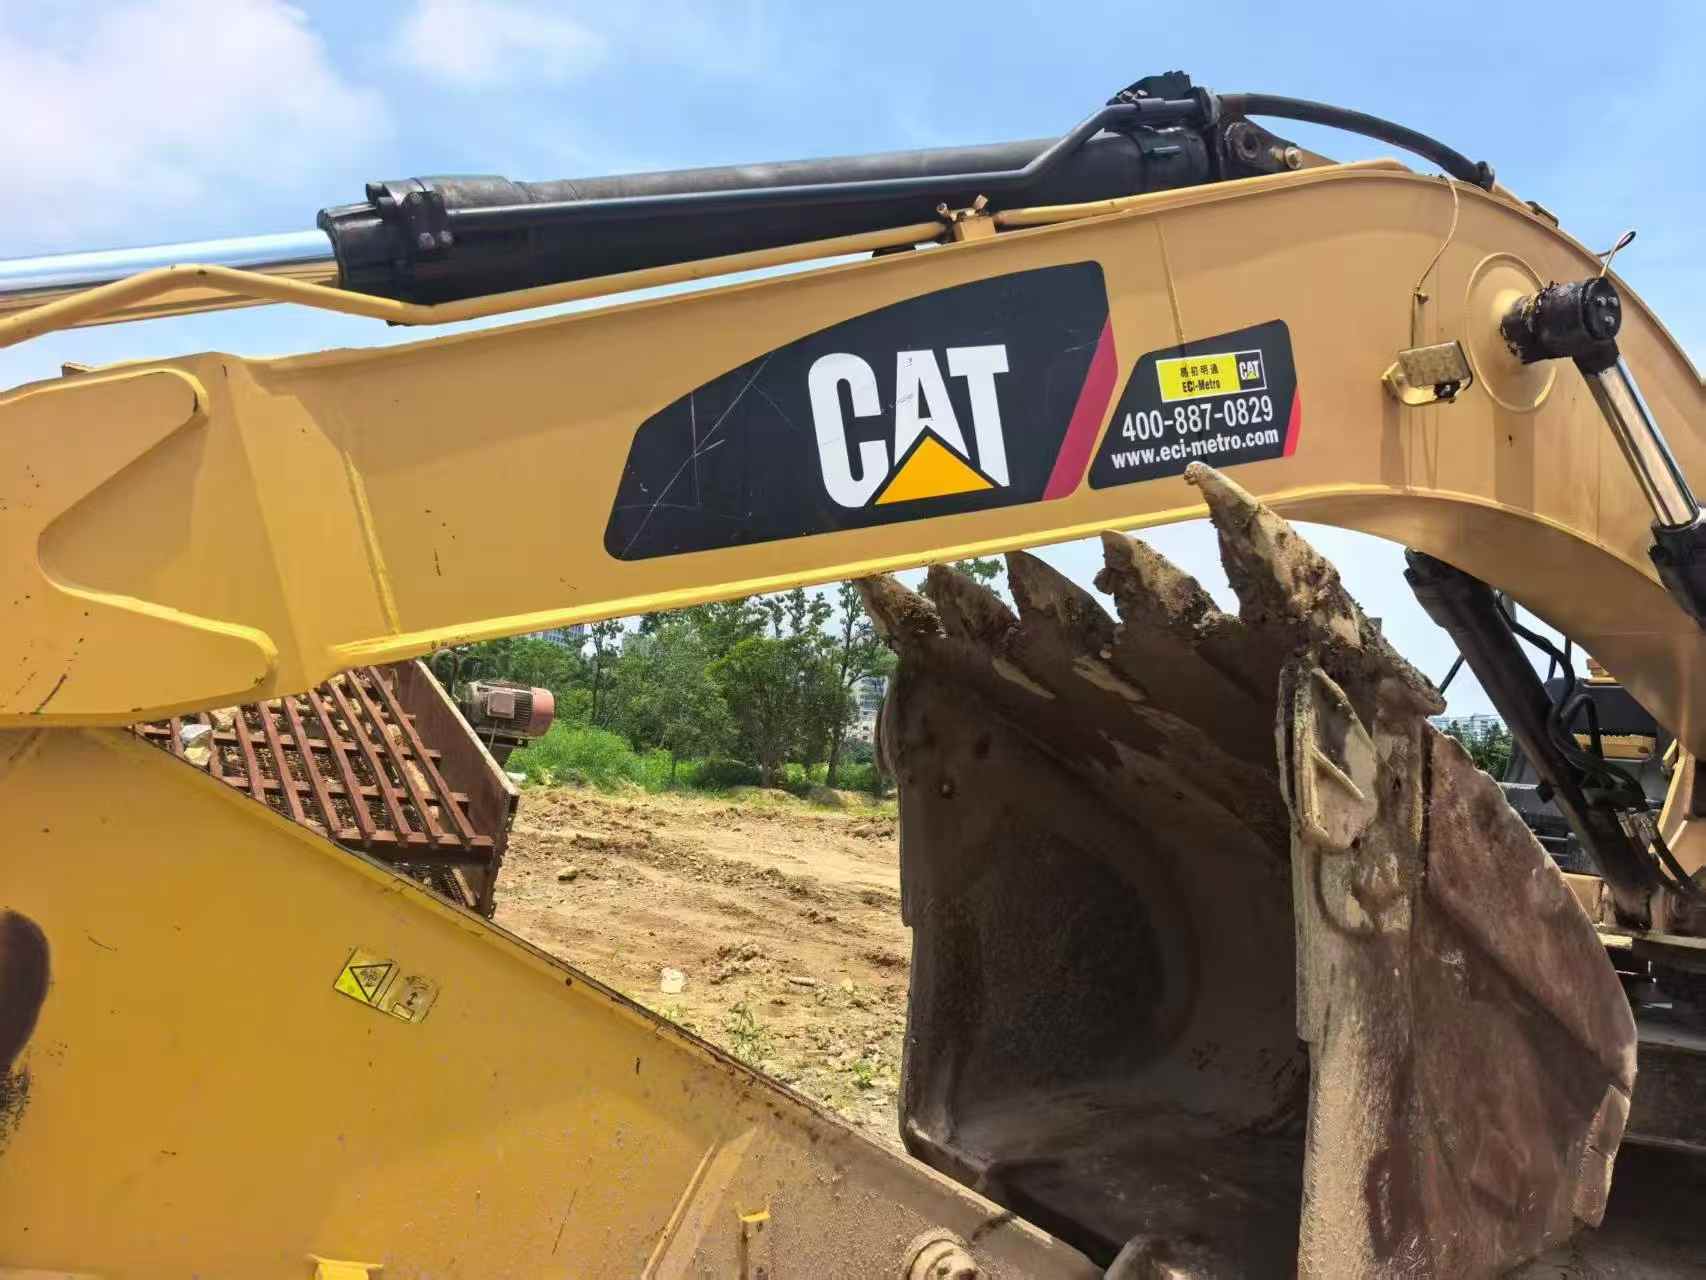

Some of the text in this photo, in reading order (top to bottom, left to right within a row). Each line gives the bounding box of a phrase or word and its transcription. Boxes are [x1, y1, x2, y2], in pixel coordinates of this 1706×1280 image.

[1239, 360, 1260, 380] CAT
[808, 344, 1009, 508] CAT
[1122, 395, 1273, 442] 400-887-0829
[1111, 428, 1279, 469] www.eci-metro.com
